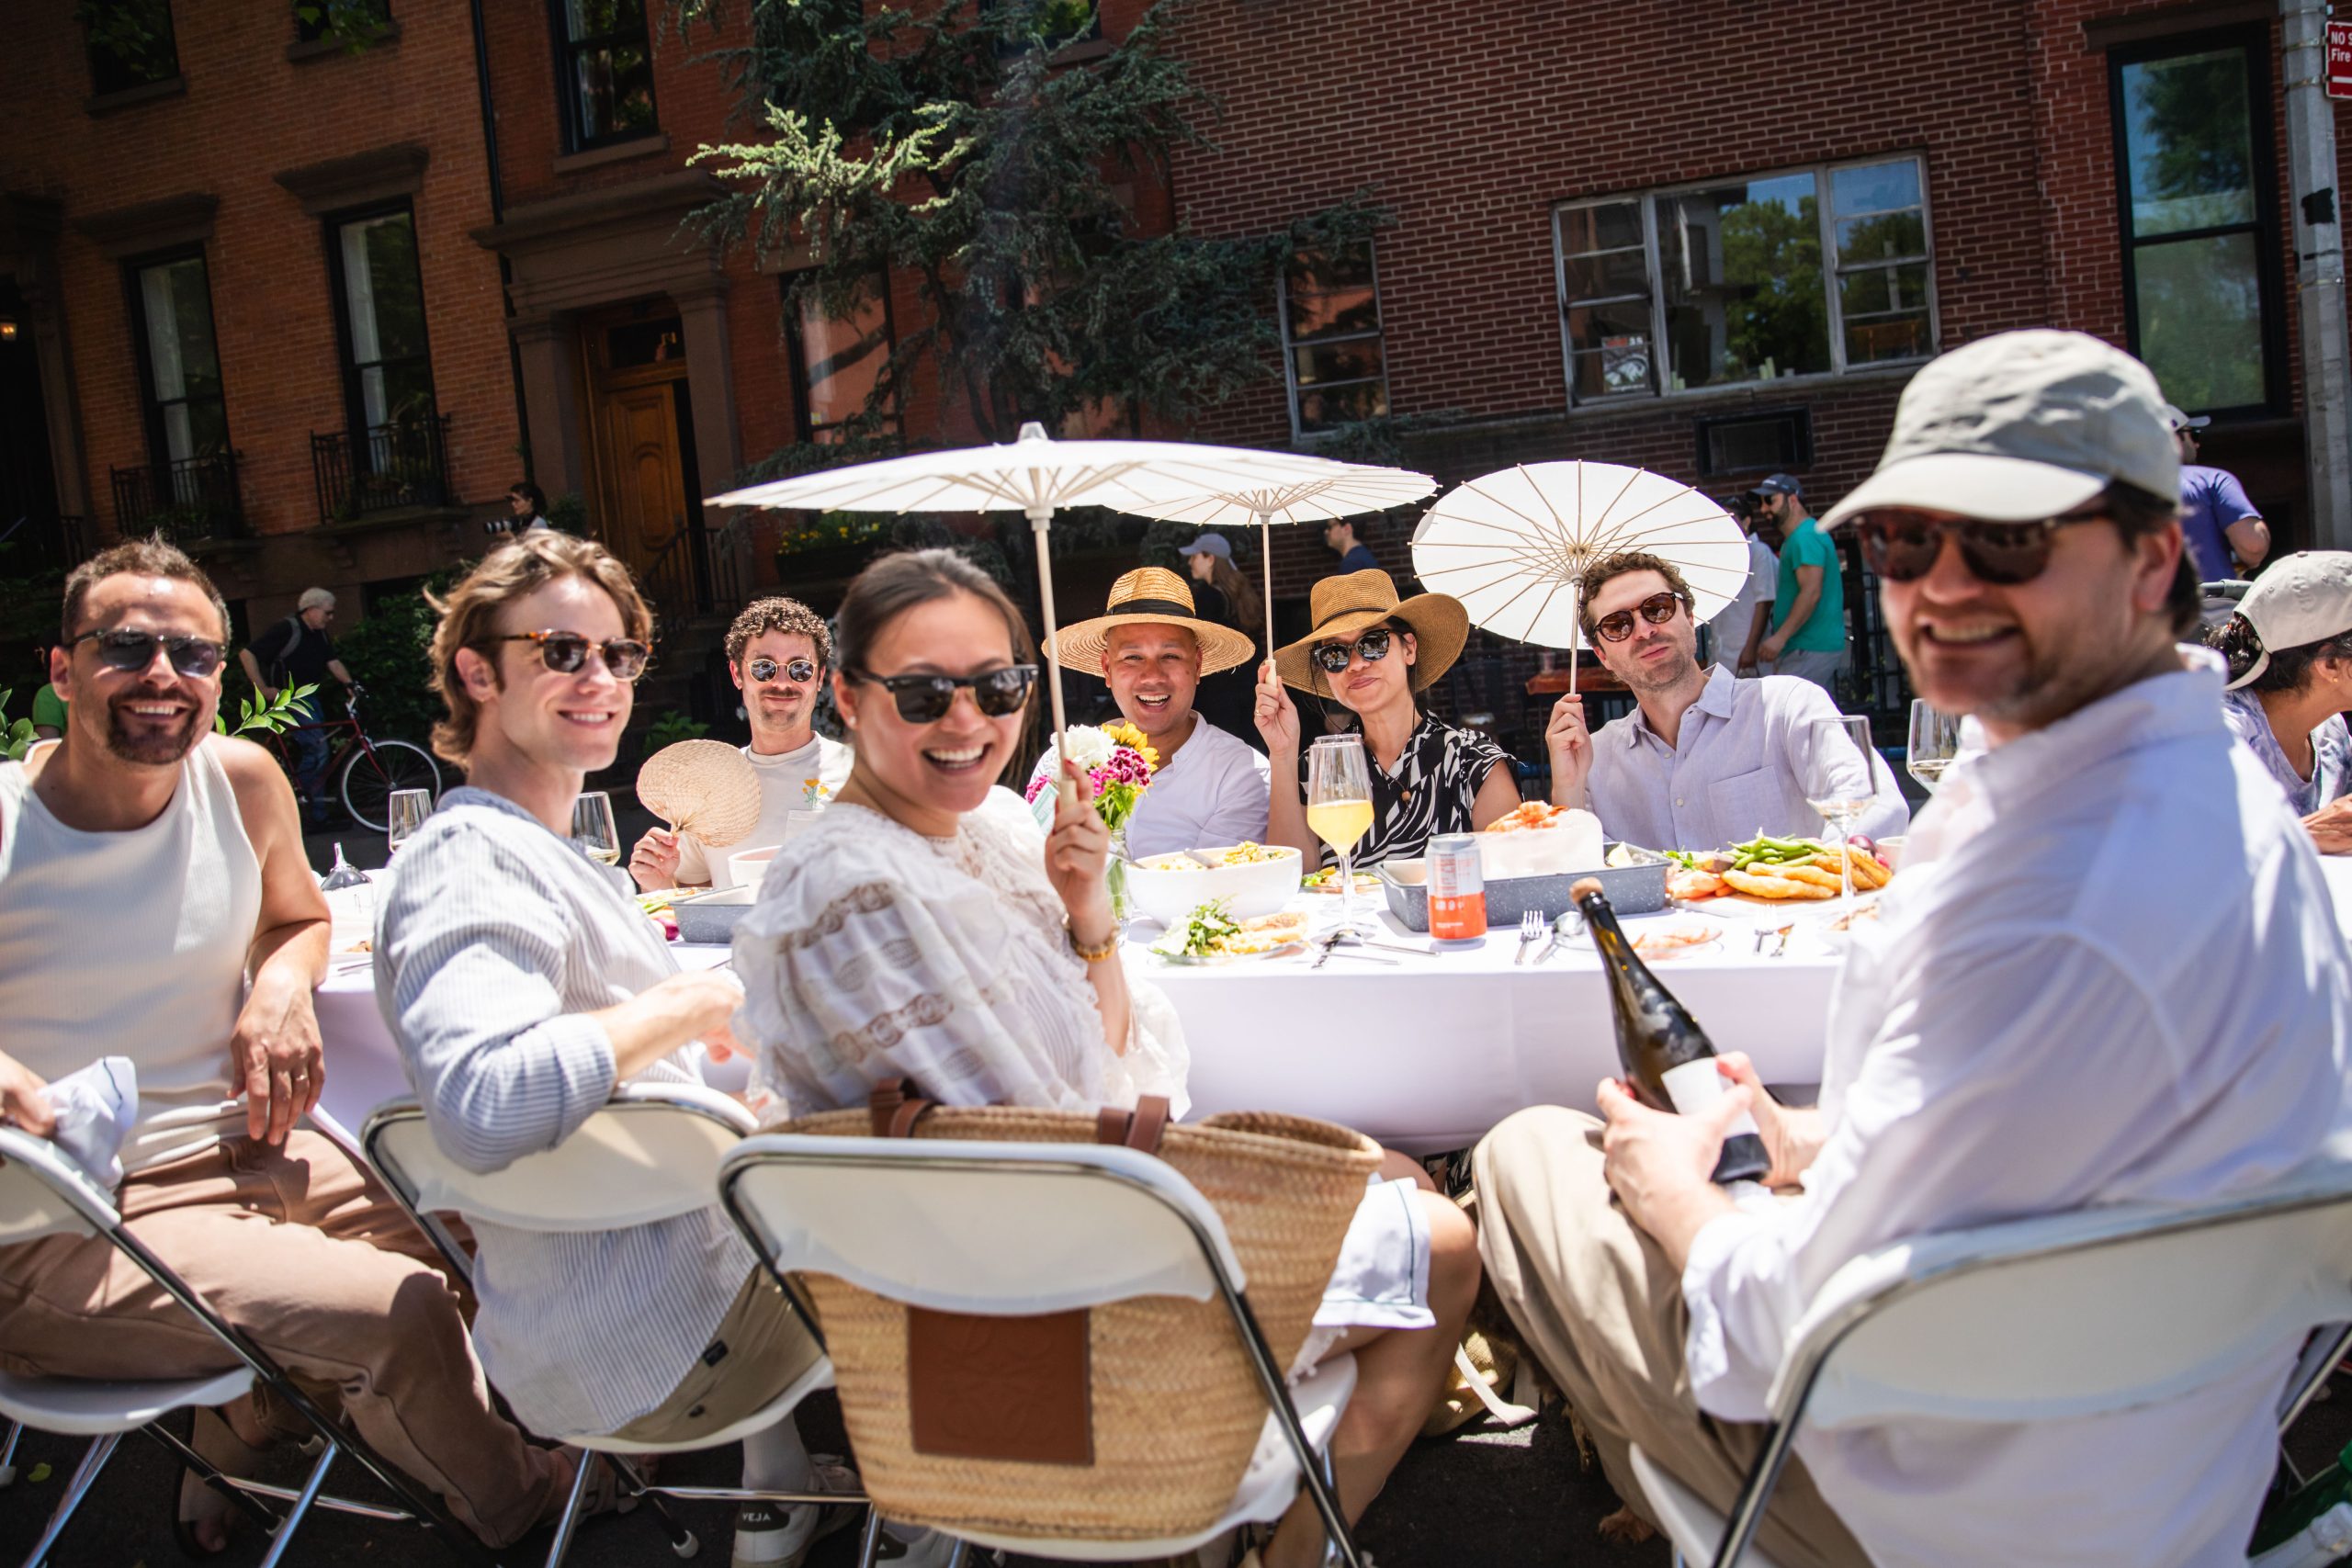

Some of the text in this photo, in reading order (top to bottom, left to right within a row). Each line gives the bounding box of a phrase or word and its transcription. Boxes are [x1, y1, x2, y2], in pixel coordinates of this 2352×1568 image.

[2331, 31, 2346, 45] NO
[2331, 48, 2351, 62] Fire
[742, 1512, 771, 1522] VEJA
